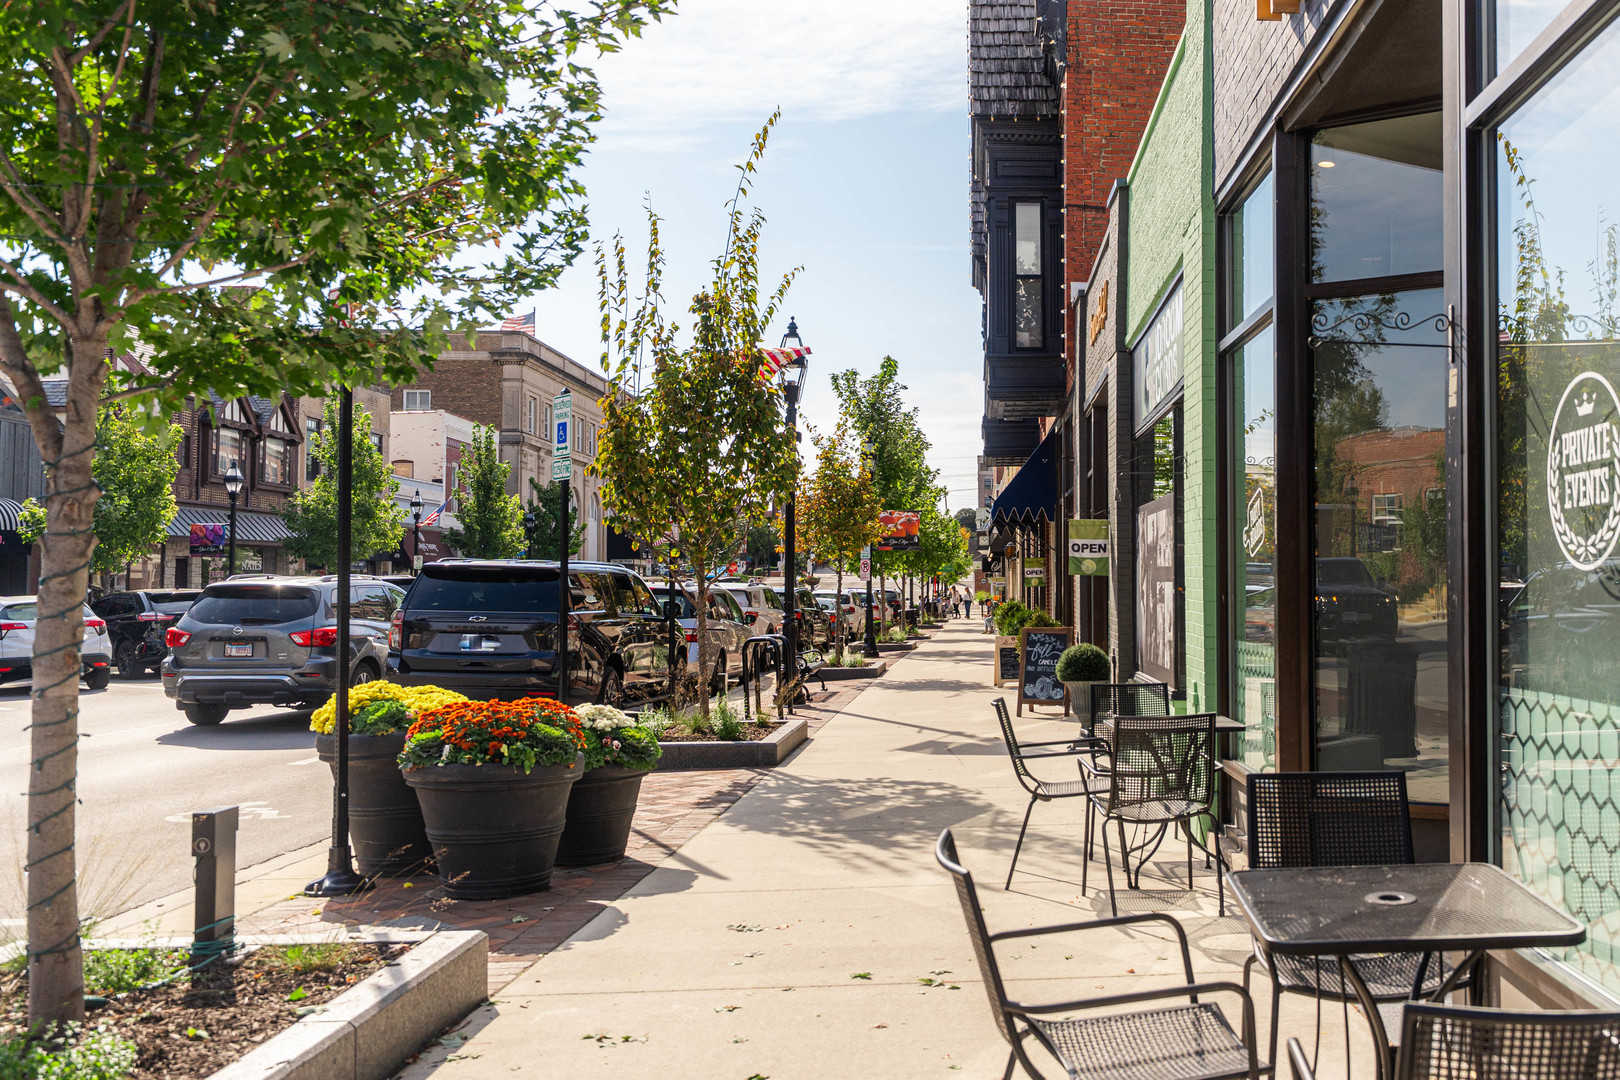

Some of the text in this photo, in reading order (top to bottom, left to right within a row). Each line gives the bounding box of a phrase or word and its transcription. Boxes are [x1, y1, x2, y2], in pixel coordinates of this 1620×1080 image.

[554, 400, 571, 411] RESERVED
[555, 411, 570, 420] PARKING
[1561, 421, 1611, 468] PRIVATE
[563, 463, 571, 473] FINE
[1564, 466, 1610, 509] EVENTS
[1071, 543, 1107, 553] OPEN
[241, 562, 262, 571] NAILS
[1026, 568, 1043, 576] OPEN
